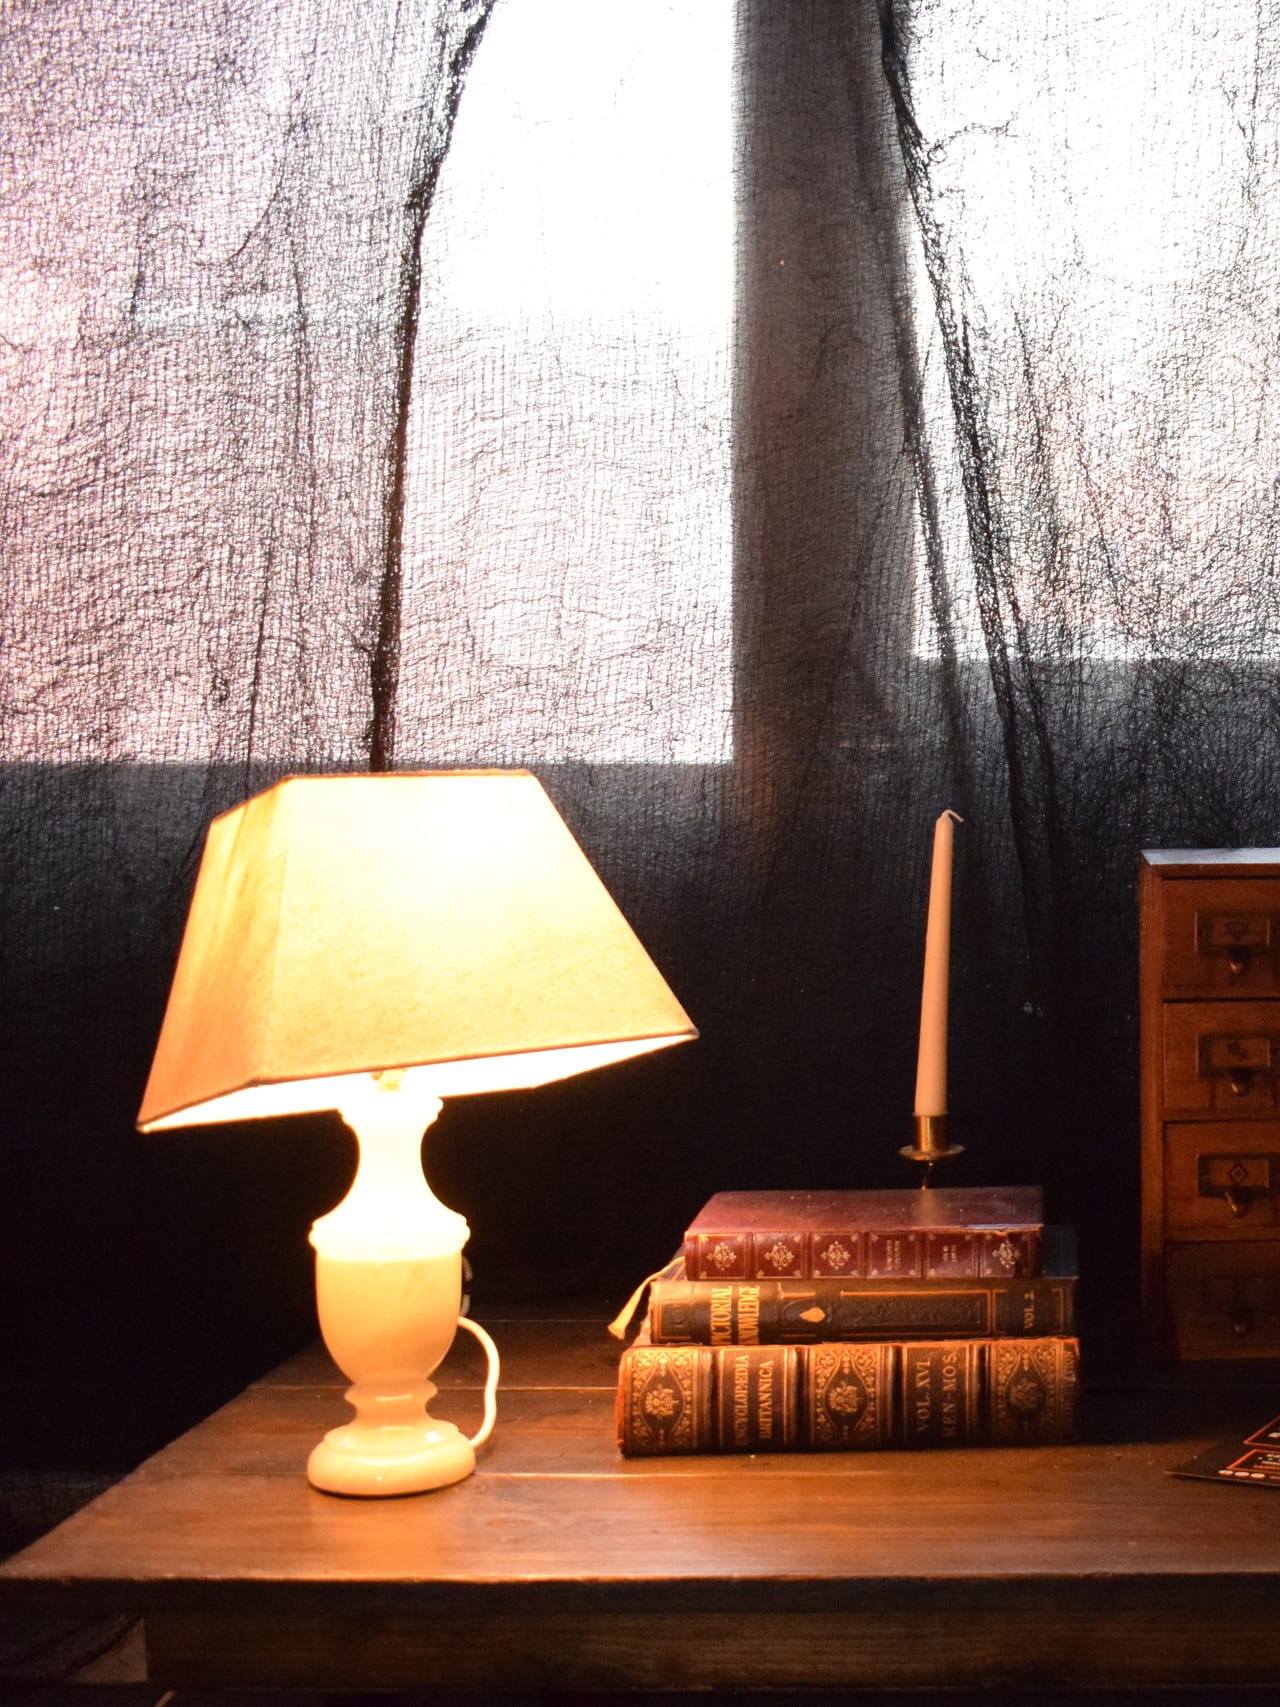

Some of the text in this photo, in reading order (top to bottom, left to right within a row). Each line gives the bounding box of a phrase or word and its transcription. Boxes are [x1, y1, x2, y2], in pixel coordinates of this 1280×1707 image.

[710, 1286, 733, 1345] PICTORIAL
[738, 1285, 761, 1345] KNOWLEDGE
[758, 1361, 773, 1439] BRITANNICA
